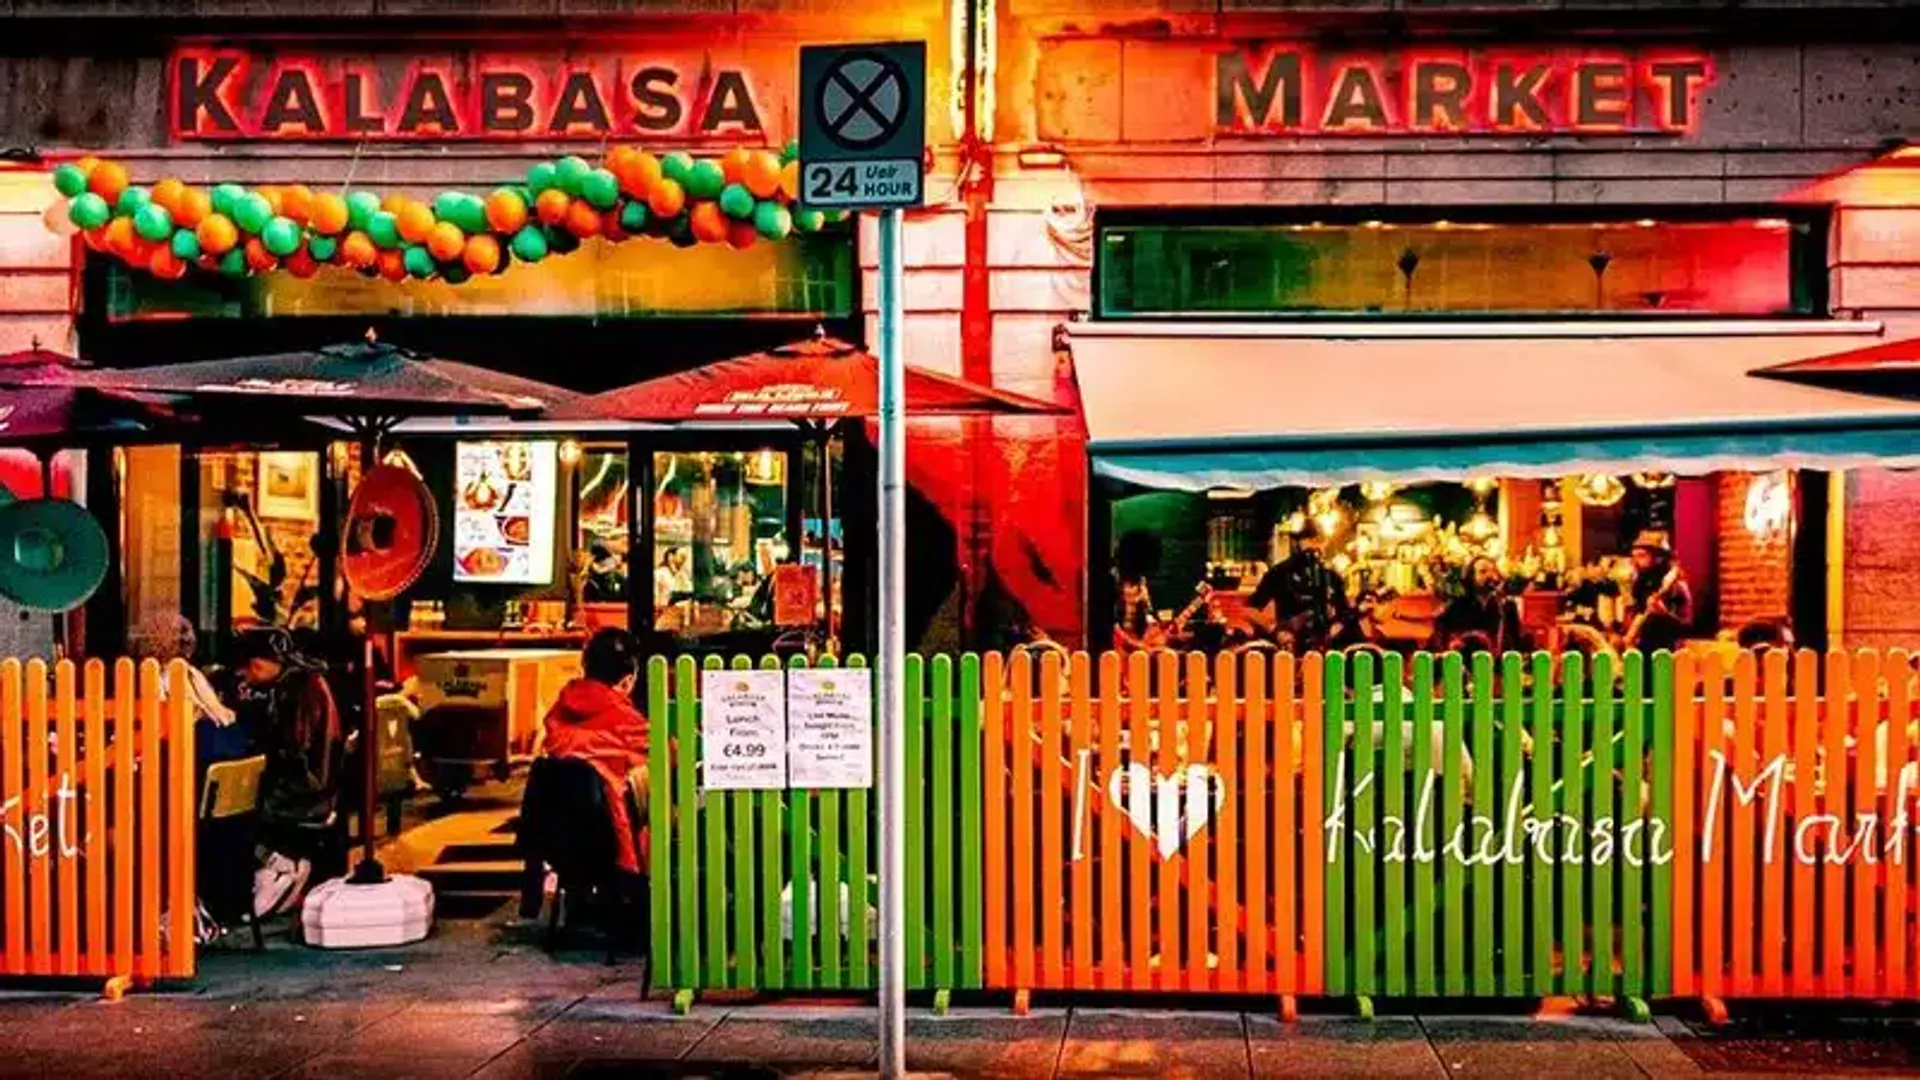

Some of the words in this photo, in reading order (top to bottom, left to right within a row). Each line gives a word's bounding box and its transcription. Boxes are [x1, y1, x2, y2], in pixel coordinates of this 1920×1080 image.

[180, 55, 760, 130] KALABASA
[1214, 51, 1705, 126] MARKET
[810, 166, 858, 198] 24
[864, 182, 913, 196] HOUR
[723, 743, 767, 758] €4.99
